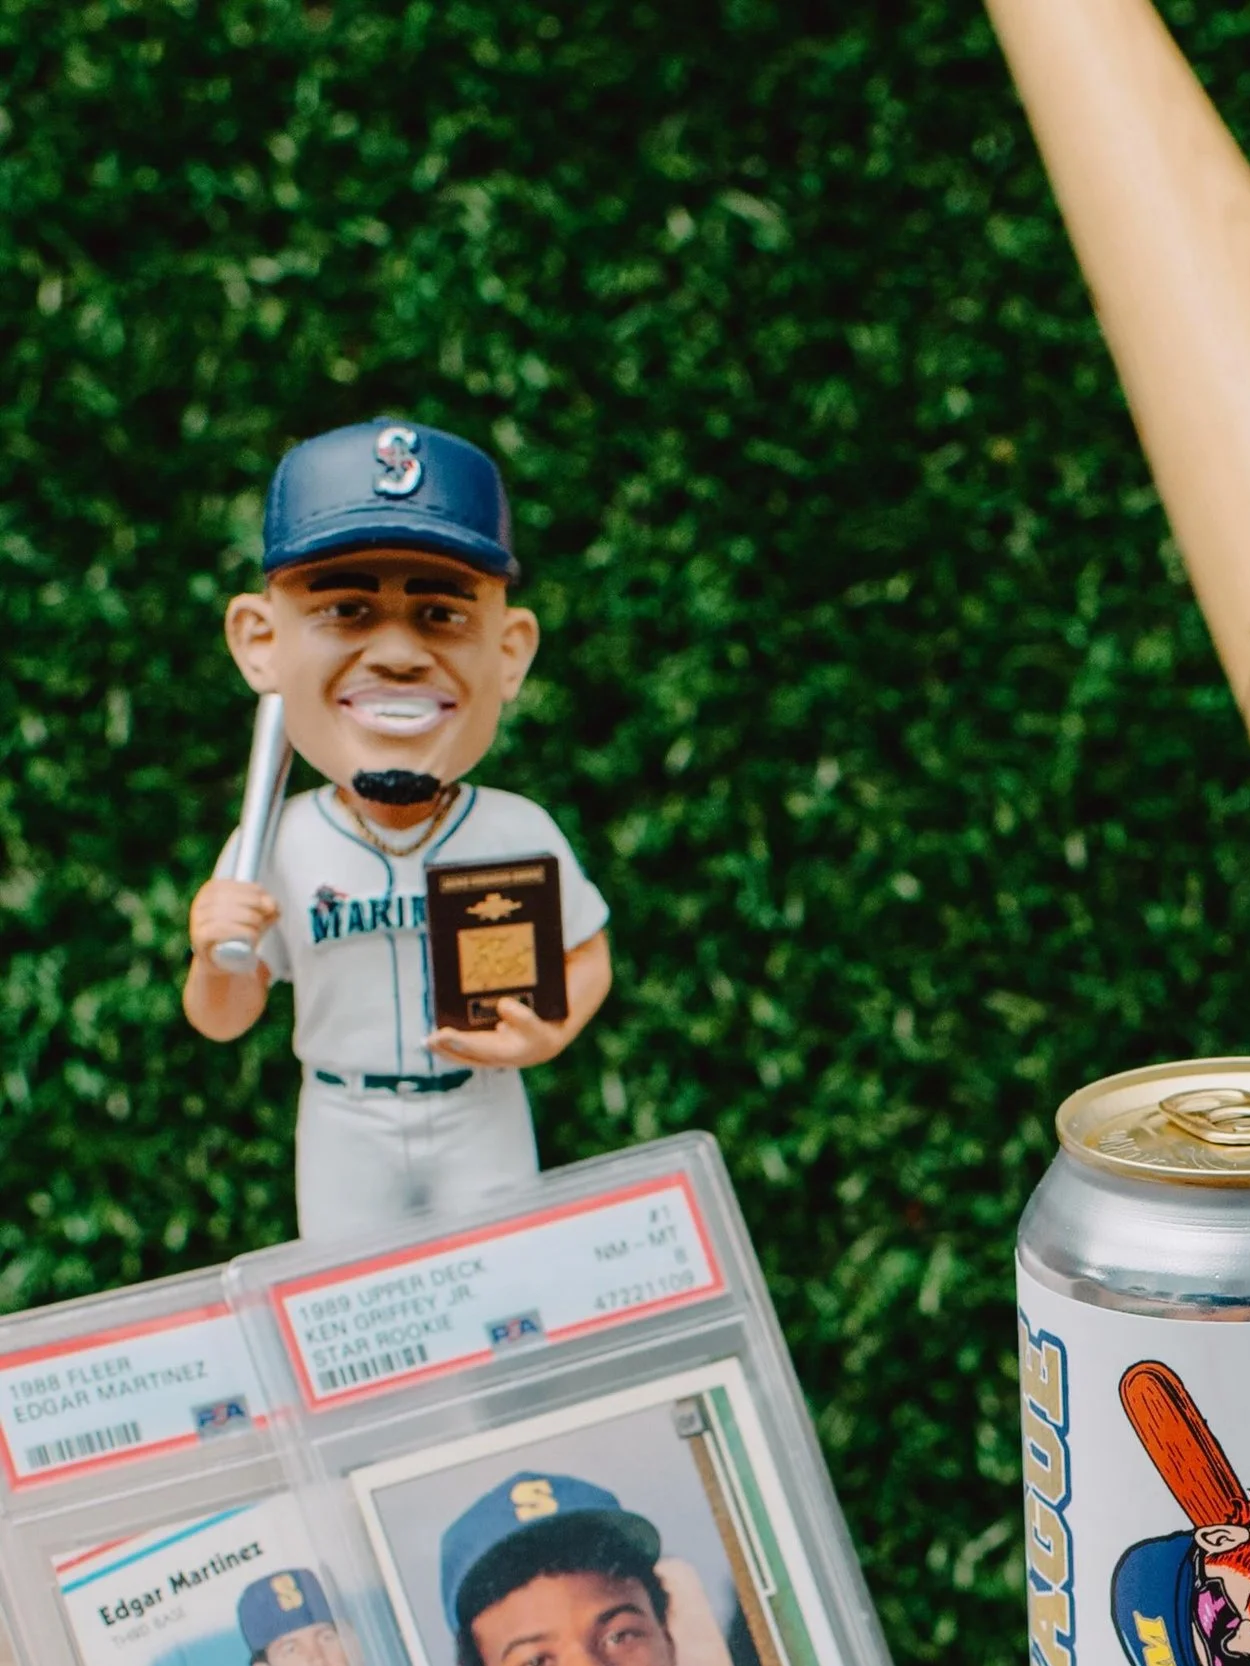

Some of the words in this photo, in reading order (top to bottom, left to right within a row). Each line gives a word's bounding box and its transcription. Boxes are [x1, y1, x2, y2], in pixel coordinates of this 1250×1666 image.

[373, 426, 423, 498] S
[309, 894, 426, 944] MARIN
[299, 1292, 351, 1324] 1989
[356, 1273, 425, 1308] UPPER
[429, 1257, 486, 1287] DECK
[305, 1319, 348, 1344] KEN
[353, 1297, 438, 1332] GRIFFEY
[312, 1337, 371, 1369] STAR
[375, 1312, 455, 1347] ROOKIE
[9, 1375, 62, 1401] 1988
[67, 1356, 133, 1386] FLEER
[13, 1392, 91, 1425] EDGAR
[96, 1360, 209, 1401] MARTINEZ
[98, 1588, 164, 1627] Edgar
[168, 1541, 265, 1595] Martinez
